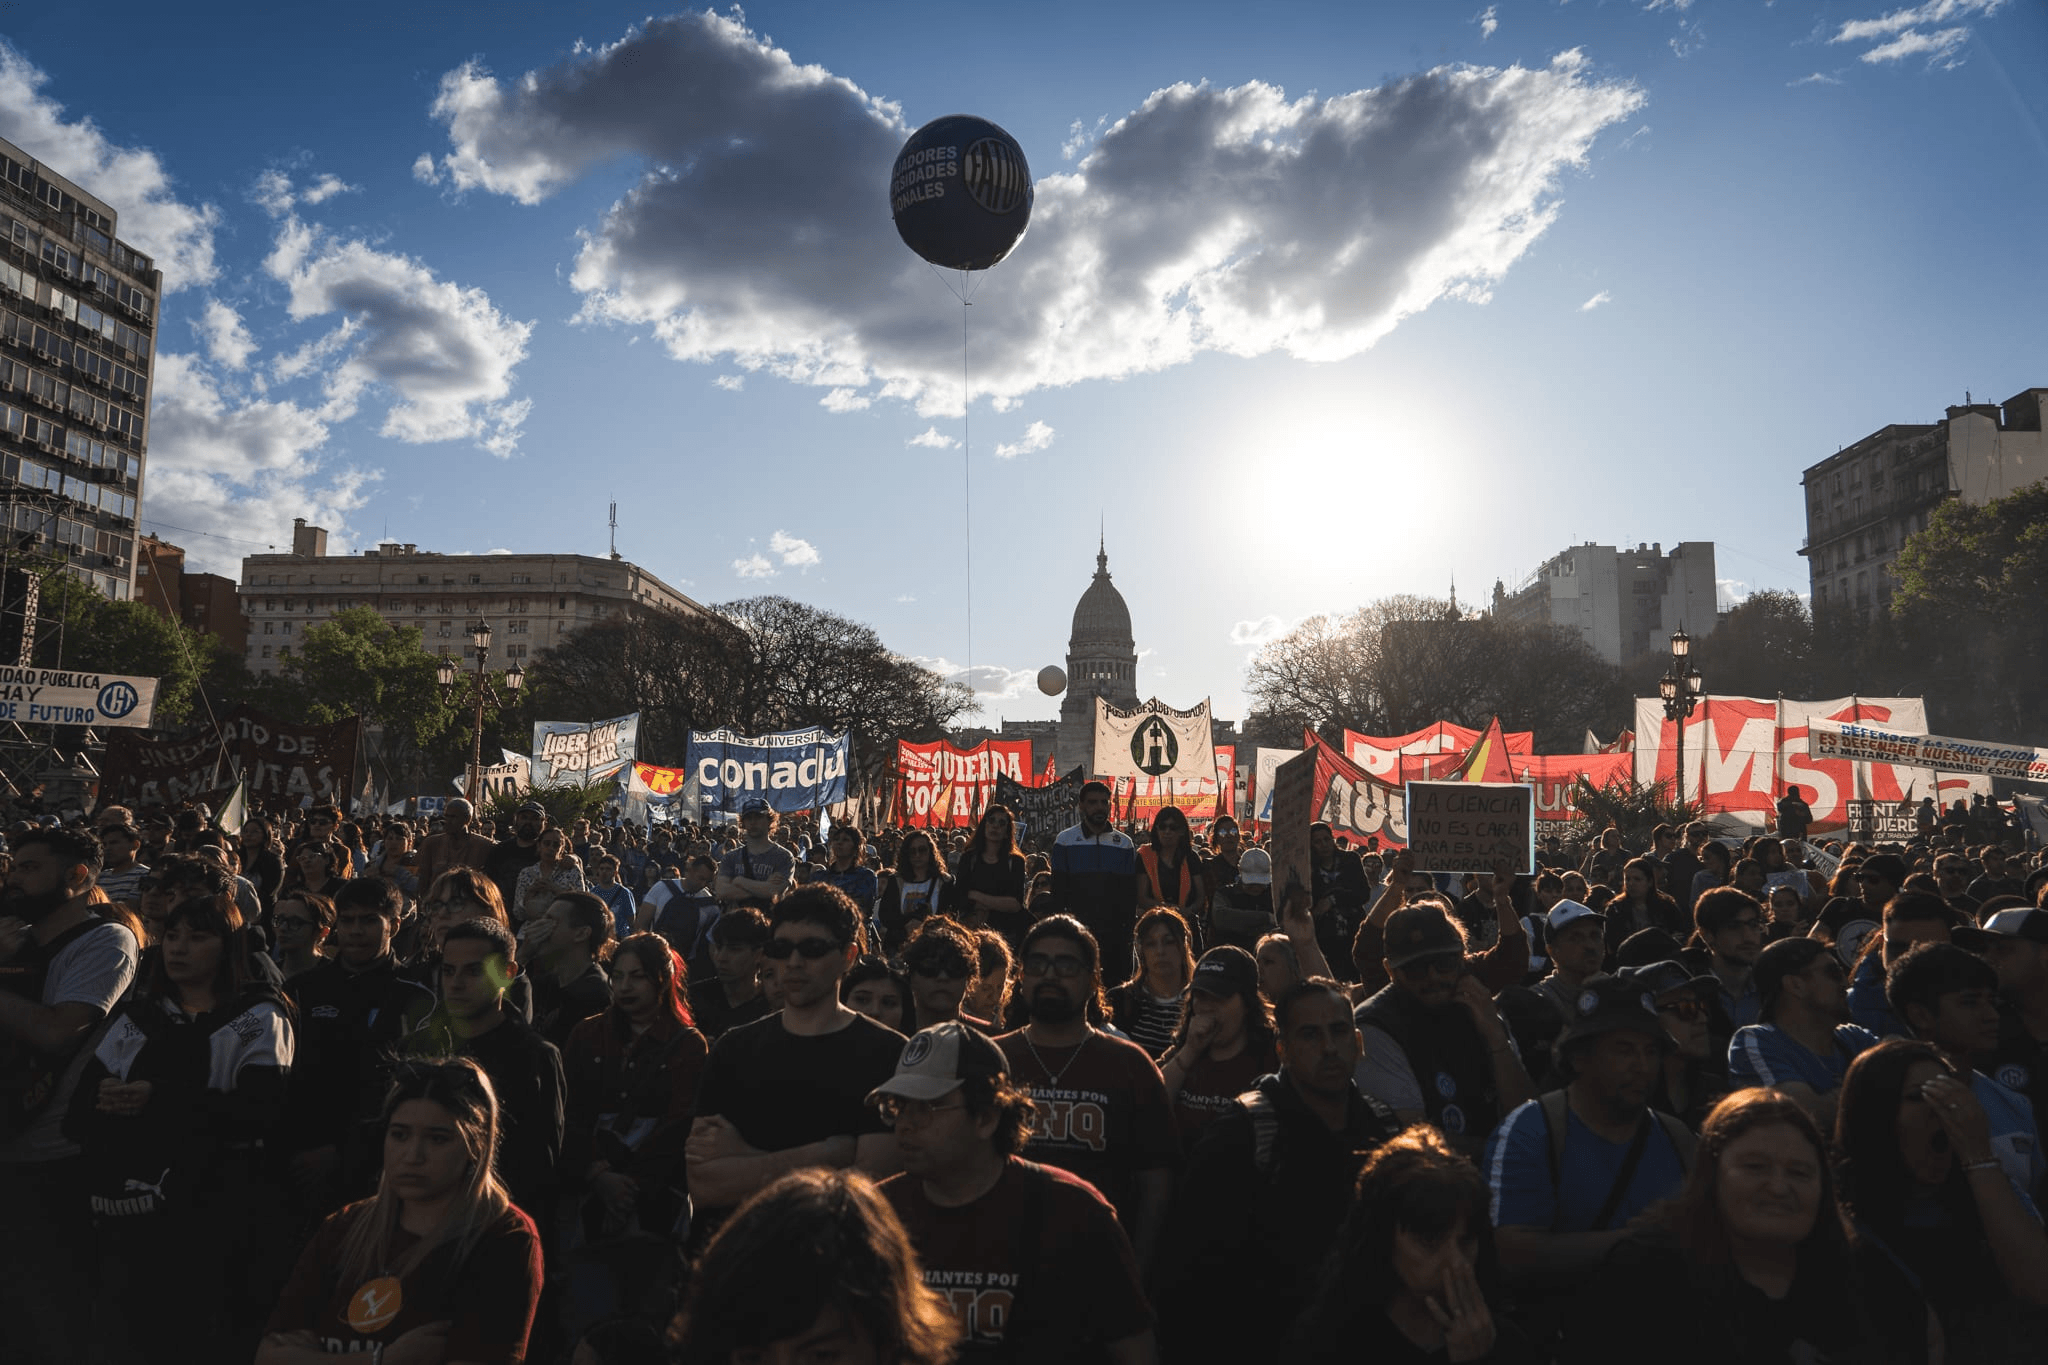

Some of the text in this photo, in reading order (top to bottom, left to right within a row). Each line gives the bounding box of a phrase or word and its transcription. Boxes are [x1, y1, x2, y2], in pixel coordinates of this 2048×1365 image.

[0, 668, 100, 690] DAD PUBLICA
[29, 704, 95, 723] FUTURO
[276, 733, 317, 755] DE
[541, 722, 619, 761] LIBERCION
[1820, 733, 1837, 746] ES
[1842, 735, 1917, 757] DEFENDER
[1994, 758, 2048, 773] FUTUR
[1820, 746, 1836, 754] LA
[1840, 747, 1900, 761] MATANZA
[467, 763, 519, 776] EUDIANTES
[698, 747, 847, 791] conadu
[1414, 791, 1521, 814] LA CIENCIA
[1417, 818, 1441, 835] NO
[1448, 821, 1470, 836] ES
[1848, 818, 1918, 833] IZQUIERD
[1411, 841, 1448, 854] CARA
[1454, 842, 1474, 854] ES
[1023, 1088, 1078, 1100] IANTES
